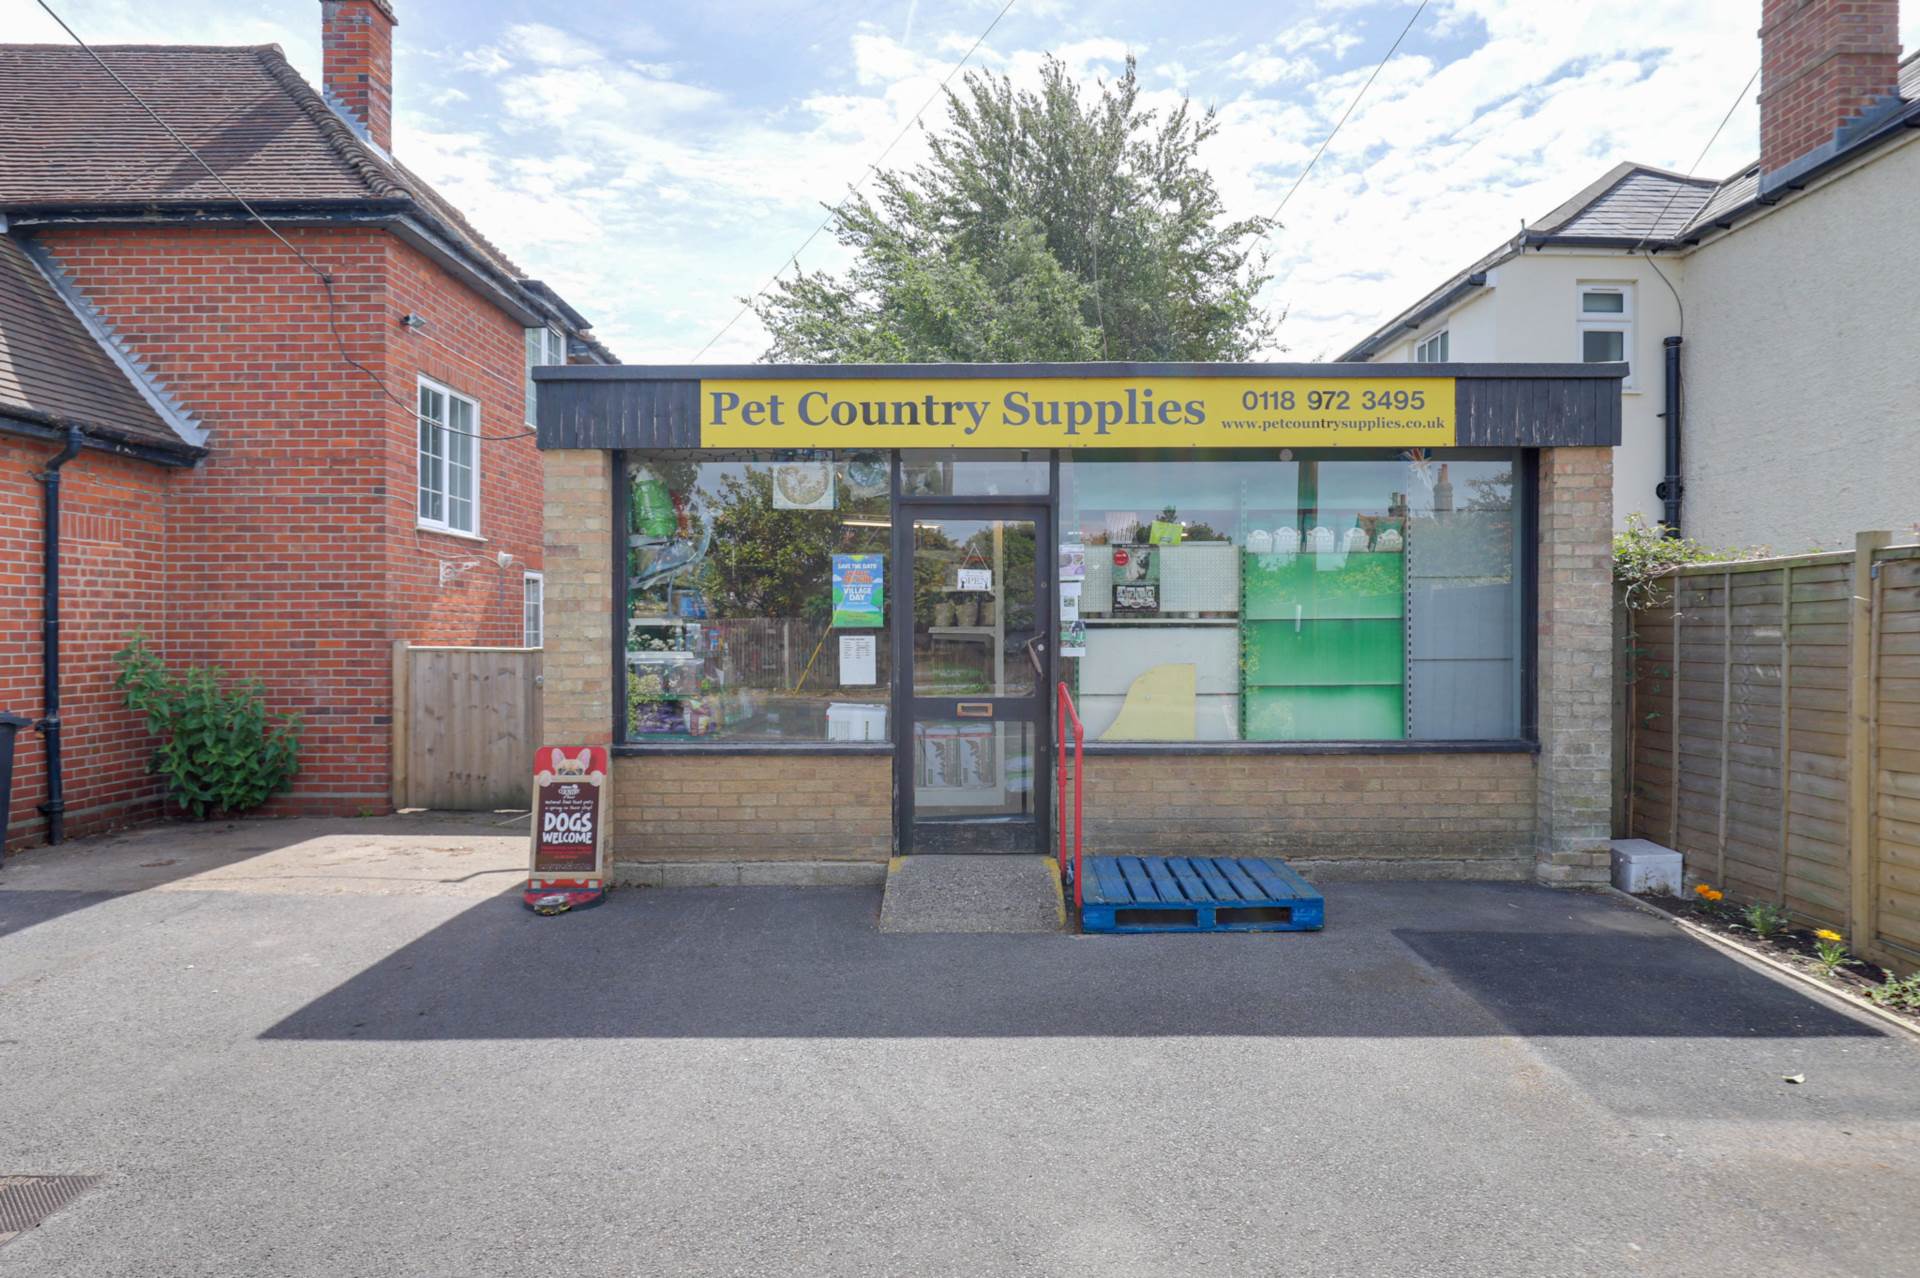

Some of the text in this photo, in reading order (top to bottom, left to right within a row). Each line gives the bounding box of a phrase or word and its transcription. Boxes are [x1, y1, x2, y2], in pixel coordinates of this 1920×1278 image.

[1241, 390, 1426, 411] 0118 972 3495
[709, 388, 1206, 435] Pet Country Supplies
[1221, 416, 1446, 432] www.petcountrysupplies.co.uk
[544, 812, 593, 832] DOGS
[542, 831, 593, 844] WELCOME
